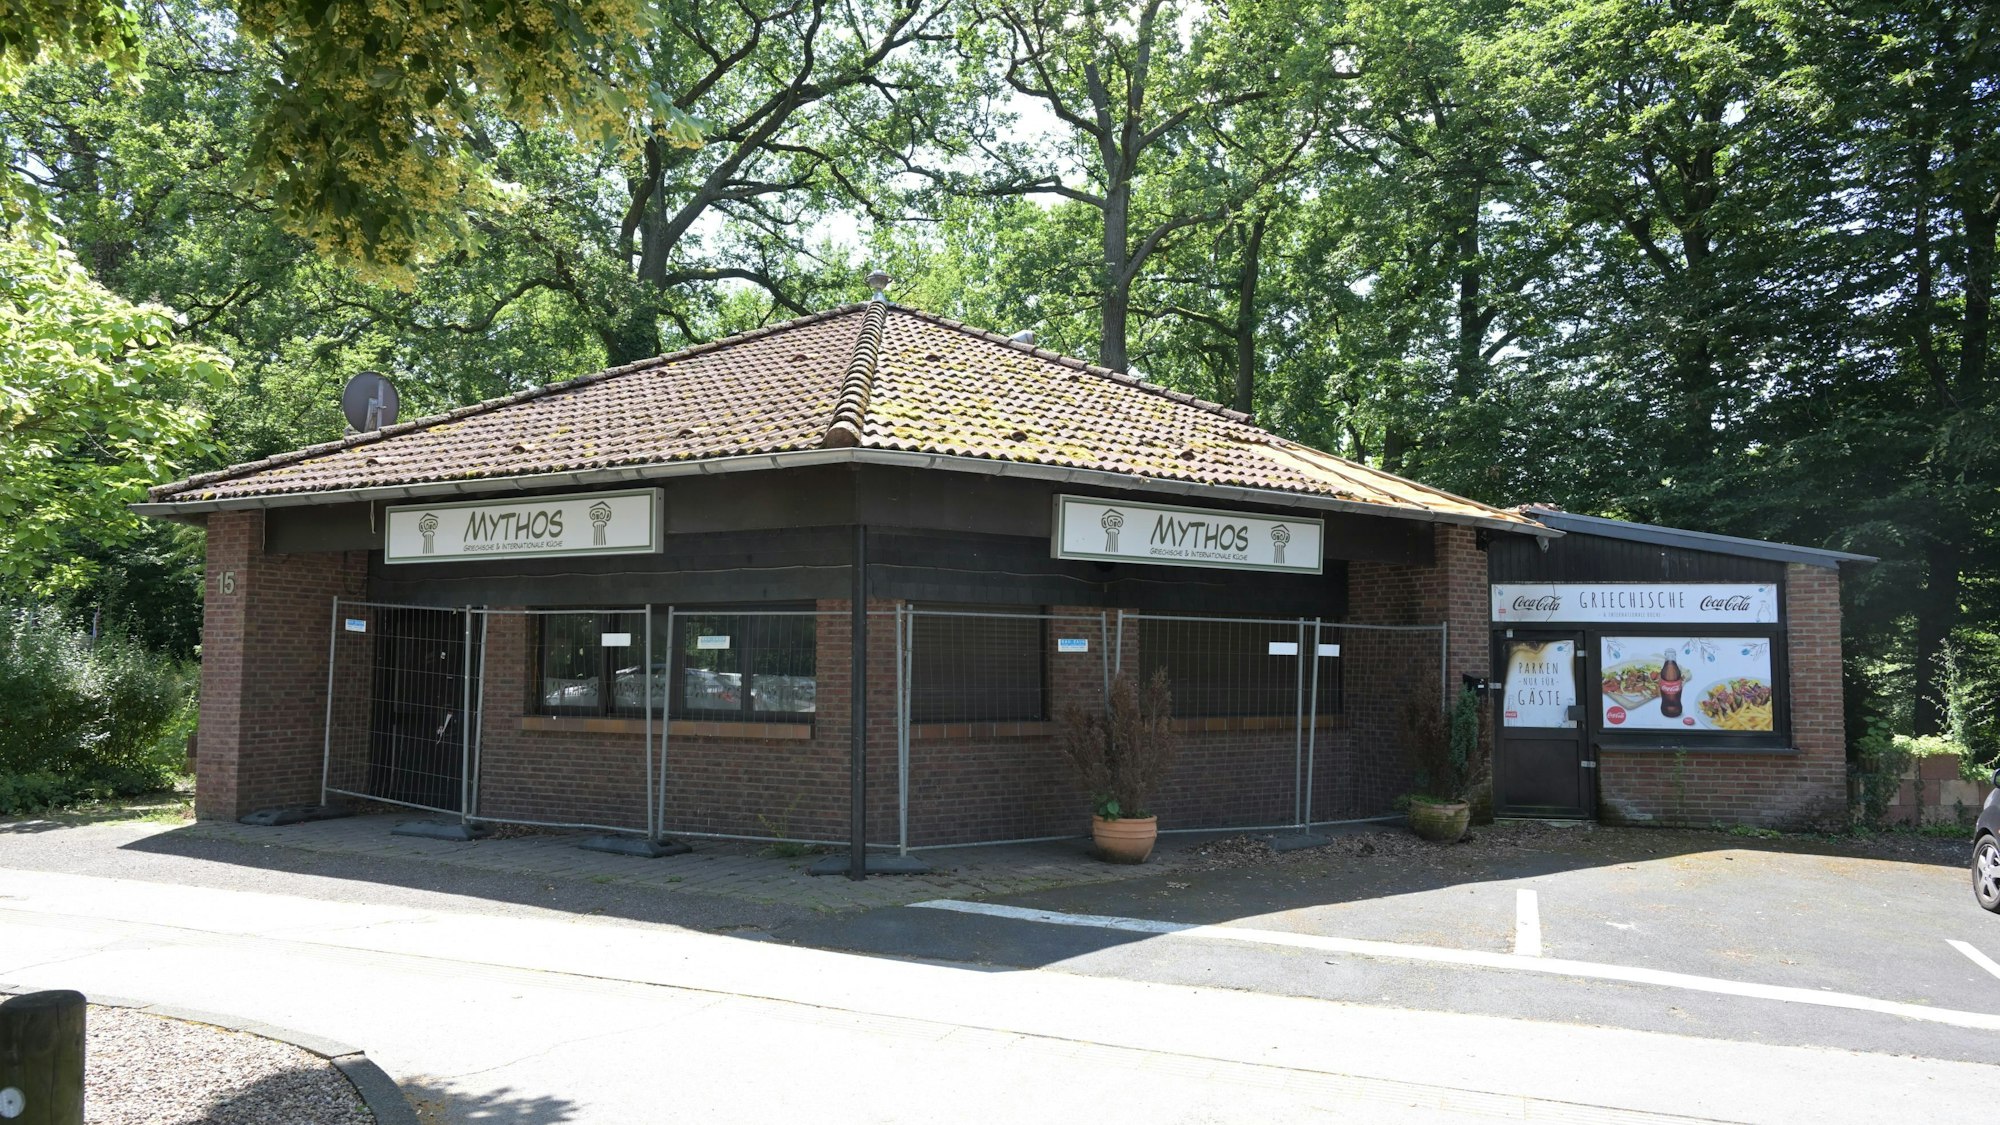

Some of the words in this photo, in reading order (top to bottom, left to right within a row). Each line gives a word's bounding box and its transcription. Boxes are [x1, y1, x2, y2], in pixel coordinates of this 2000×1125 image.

[463, 509, 564, 542] MYTHOS
[1150, 514, 1249, 552] MYTHOS
[463, 543, 495, 552] GRIECHISCHE
[502, 540, 545, 550] INTERNATIONALE
[546, 540, 563, 548] KÜCHE
[1149, 547, 1183, 557] GRIECHISCHE
[1190, 550, 1232, 560] INTERNATIONALE
[1232, 552, 1248, 561] KÜCHE
[216, 571, 236, 595] 15
[1579, 591, 1684, 609] GRIECHISCHE
[1519, 662, 1559, 675] PARKEN
[1523, 677, 1538, 686] NUR
[1541, 676, 1555, 686] FÜR
[1517, 687, 1560, 706] GÄSTE
